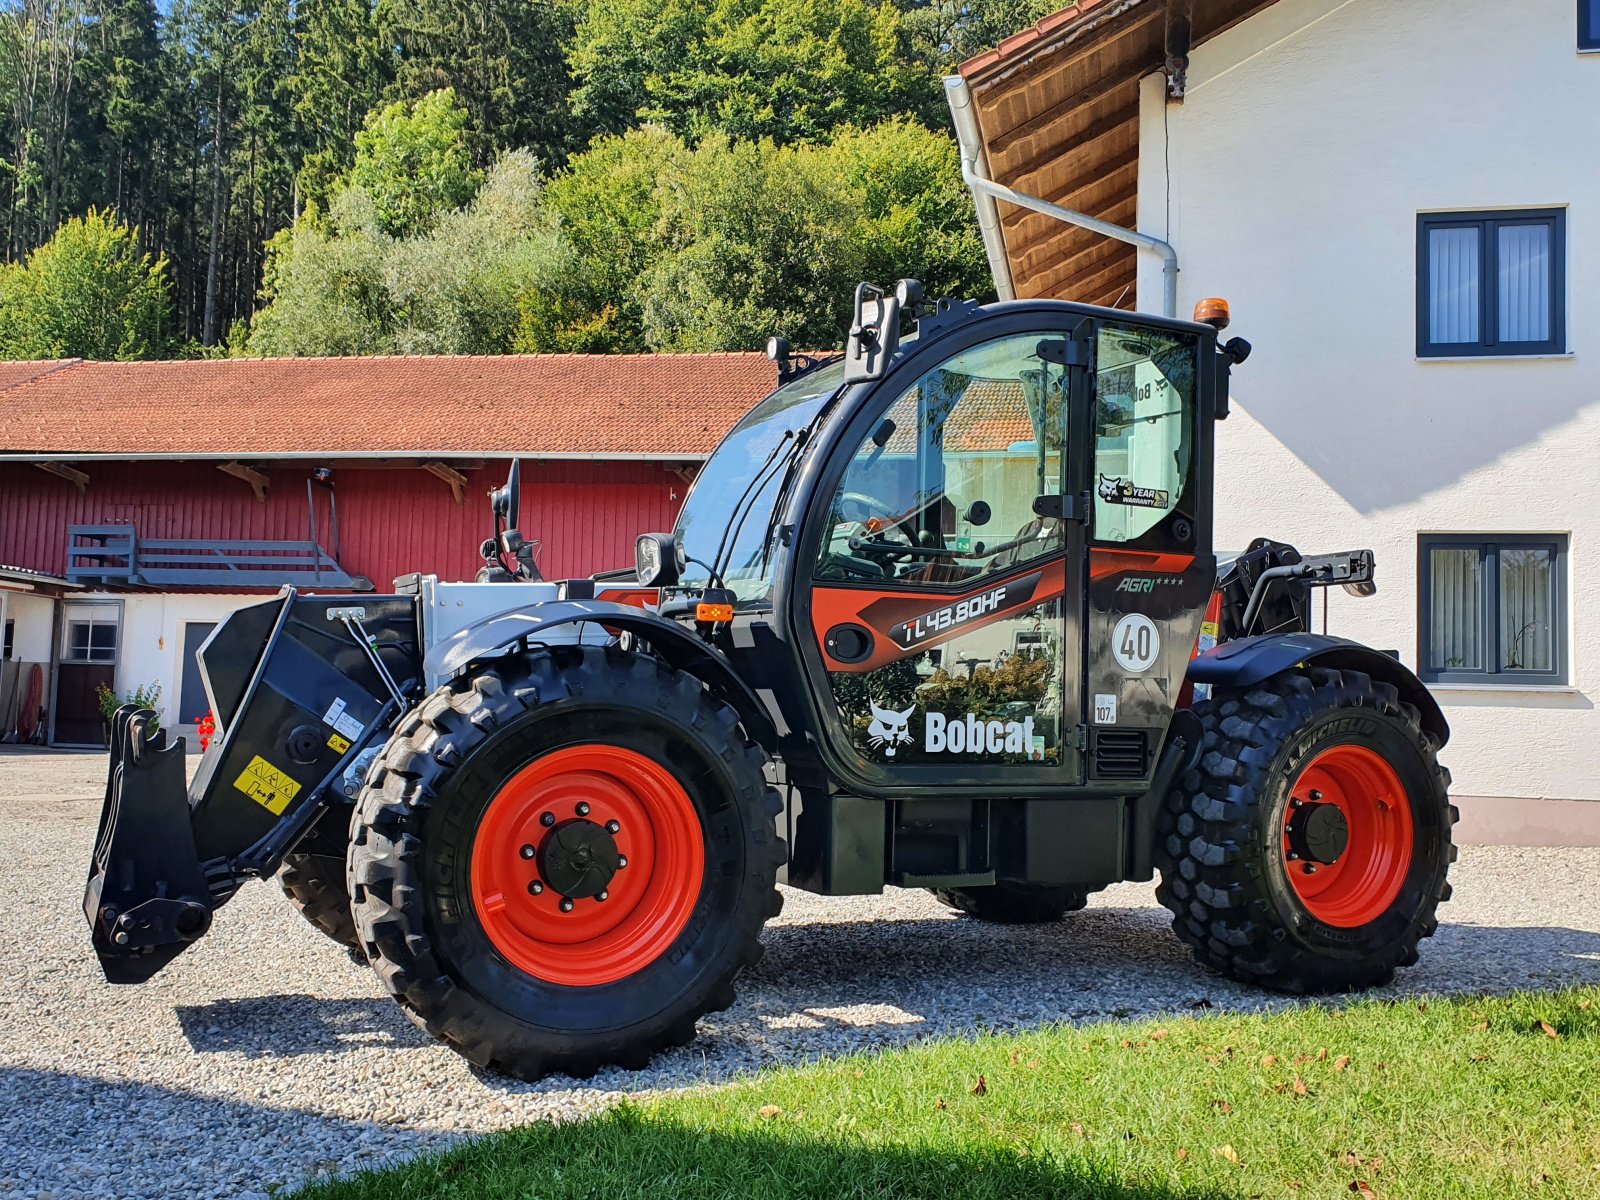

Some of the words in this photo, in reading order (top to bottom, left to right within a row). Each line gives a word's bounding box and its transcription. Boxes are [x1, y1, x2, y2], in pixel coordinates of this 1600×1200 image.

[1123, 481, 1134, 496] 3
[1133, 488, 1155, 498] YEAR
[1122, 496, 1155, 506] WARRANTY
[1116, 577, 1156, 592] AGRI
[1120, 624, 1151, 661] 40
[1096, 706, 1111, 721] 107
[925, 711, 1035, 754] Bobcat
[1298, 718, 1377, 758] MICHELIN
